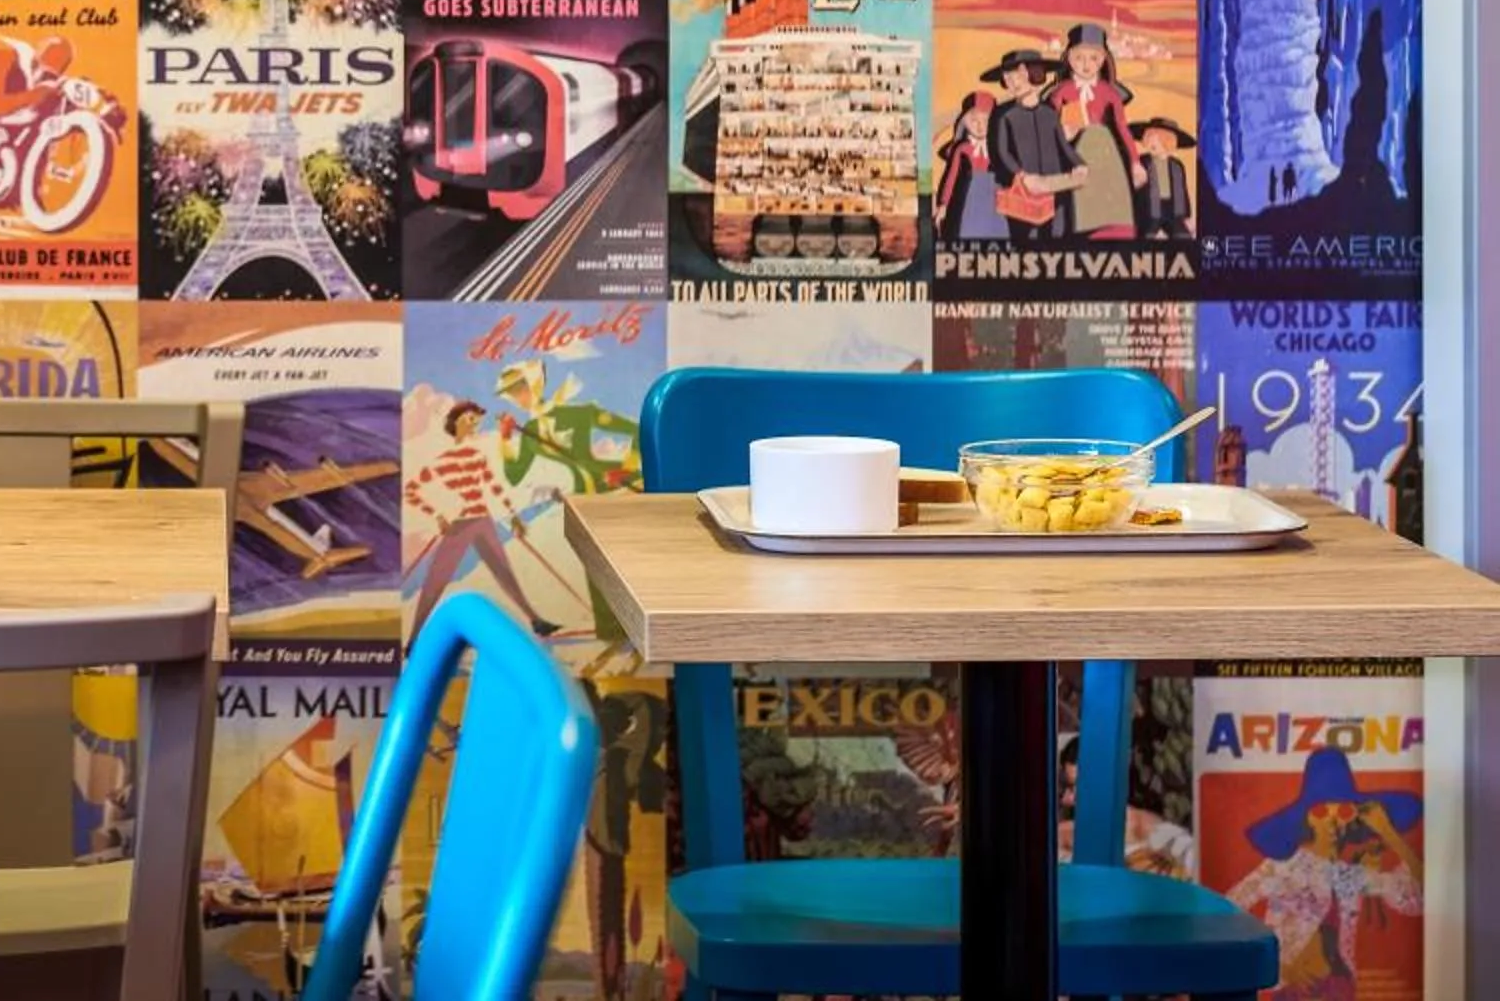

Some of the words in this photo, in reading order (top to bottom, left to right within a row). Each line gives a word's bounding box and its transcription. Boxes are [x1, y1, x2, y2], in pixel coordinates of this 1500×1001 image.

[29, 8, 68, 27] seul
[76, 7, 118, 27] Club
[424, 0, 473, 17] GOES
[147, 47, 396, 86] PARIS
[210, 92, 274, 115] TWA
[287, 92, 364, 115] JETS
[1289, 235, 1424, 257] AMERIC
[38, 249, 58, 266] DE
[67, 249, 131, 266] FRANCE
[934, 252, 1196, 280] PENNSYLVANIA
[672, 281, 700, 302] TO
[704, 280, 731, 302] ALL
[734, 280, 793, 302] PARTS
[797, 280, 820, 302] OF
[824, 280, 854, 302] THE
[856, 280, 928, 302] WORLD
[935, 301, 1003, 318] RANGER
[1009, 302, 1112, 318] NATURALIST
[155, 346, 277, 358] AMERICAN
[282, 346, 380, 358] AIRLINES
[1274, 332, 1377, 353] CHICAGO
[243, 648, 271, 664] And
[276, 648, 301, 665] You
[305, 648, 328, 666] Fly
[332, 647, 395, 665] Assured
[295, 685, 389, 719] MAIL
[744, 688, 946, 728] EXICO
[1206, 711, 1423, 759] ARIZONA
